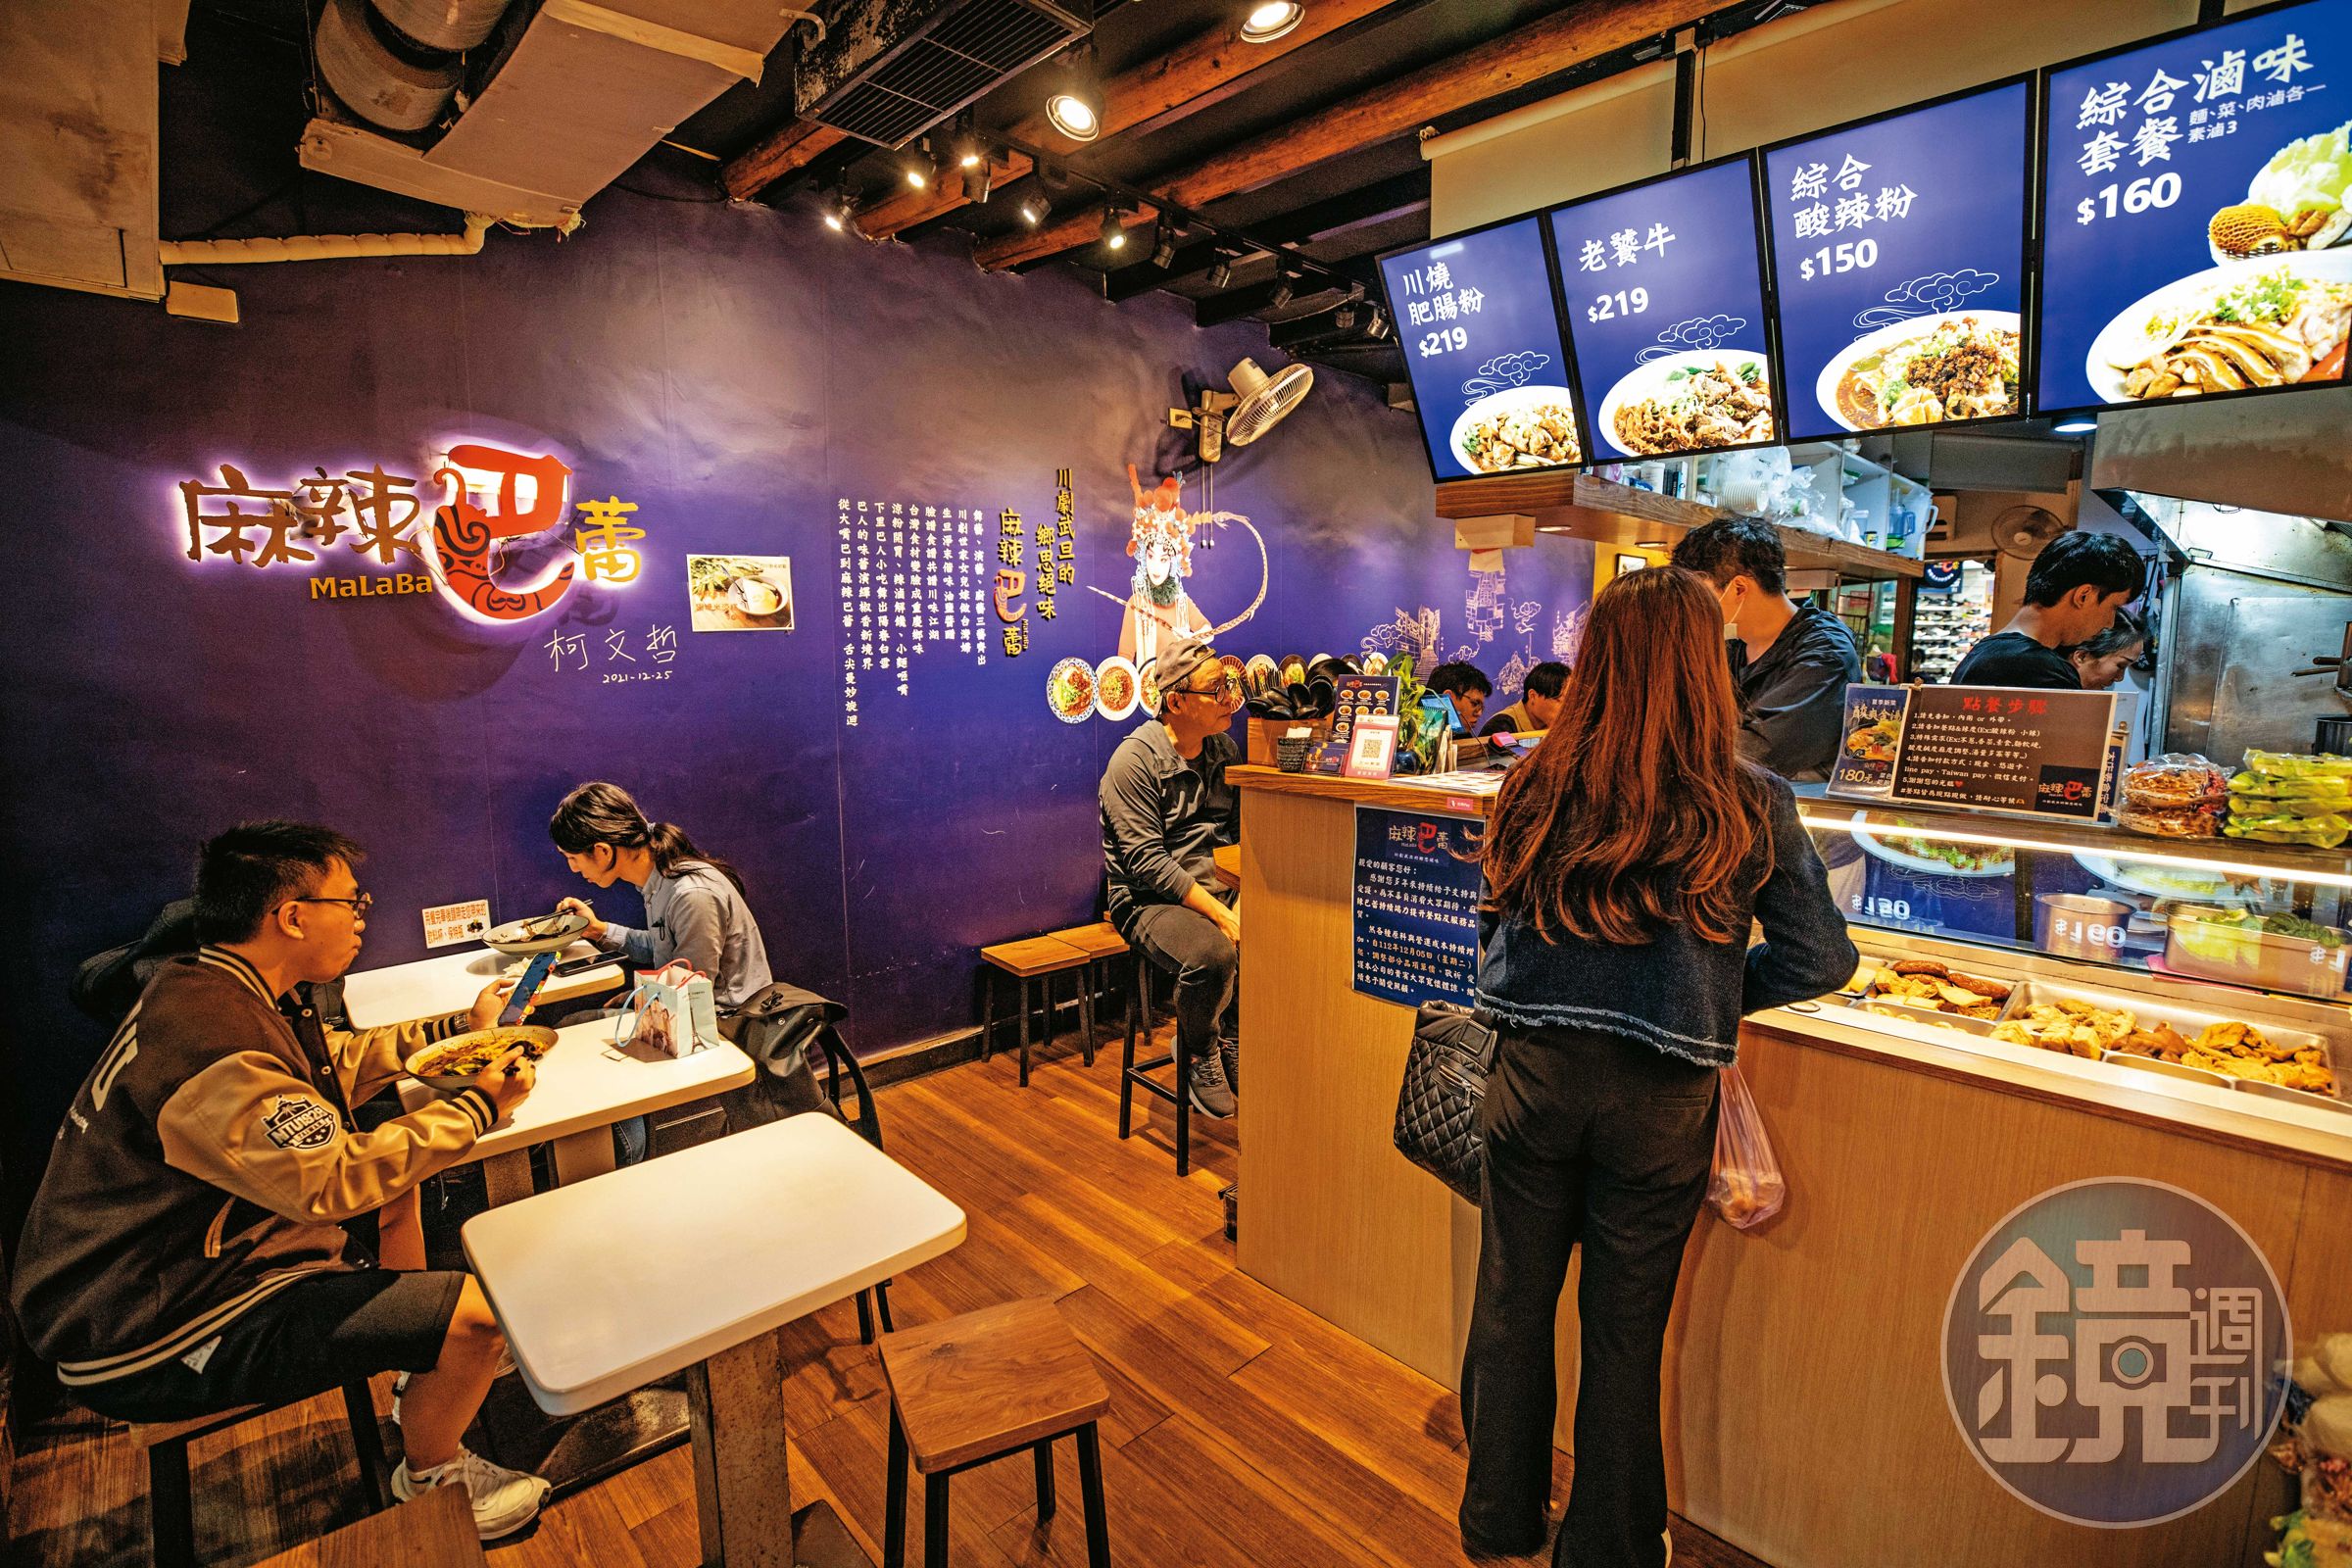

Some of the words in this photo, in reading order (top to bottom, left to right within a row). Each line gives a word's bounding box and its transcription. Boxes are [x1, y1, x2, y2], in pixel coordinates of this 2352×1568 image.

[2076, 33, 2314, 131] 綜合滷味
[2077, 117, 2183, 177] 套餐
[2187, 121, 2238, 144] 素滷3
[1790, 153, 1872, 202] 綜合
[2077, 172, 2182, 226] $160
[1793, 182, 1919, 240] 酸辣粉
[1578, 222, 1677, 272] 老饕牛
[1800, 238, 1879, 282] $150
[1402, 261, 1454, 296] 川燒
[1408, 286, 1485, 326] 肥腸粉
[1588, 286, 1649, 323] $219
[1419, 326, 1468, 359] $219
[178, 444, 646, 620] 麻辣巴蕾
[1056, 467, 1076, 586] 川劇武旦的
[310, 574, 433, 600] MaLaBa
[1036, 522, 1057, 620] 鄉思絕味
[544, 623, 677, 672] 柯文哲
